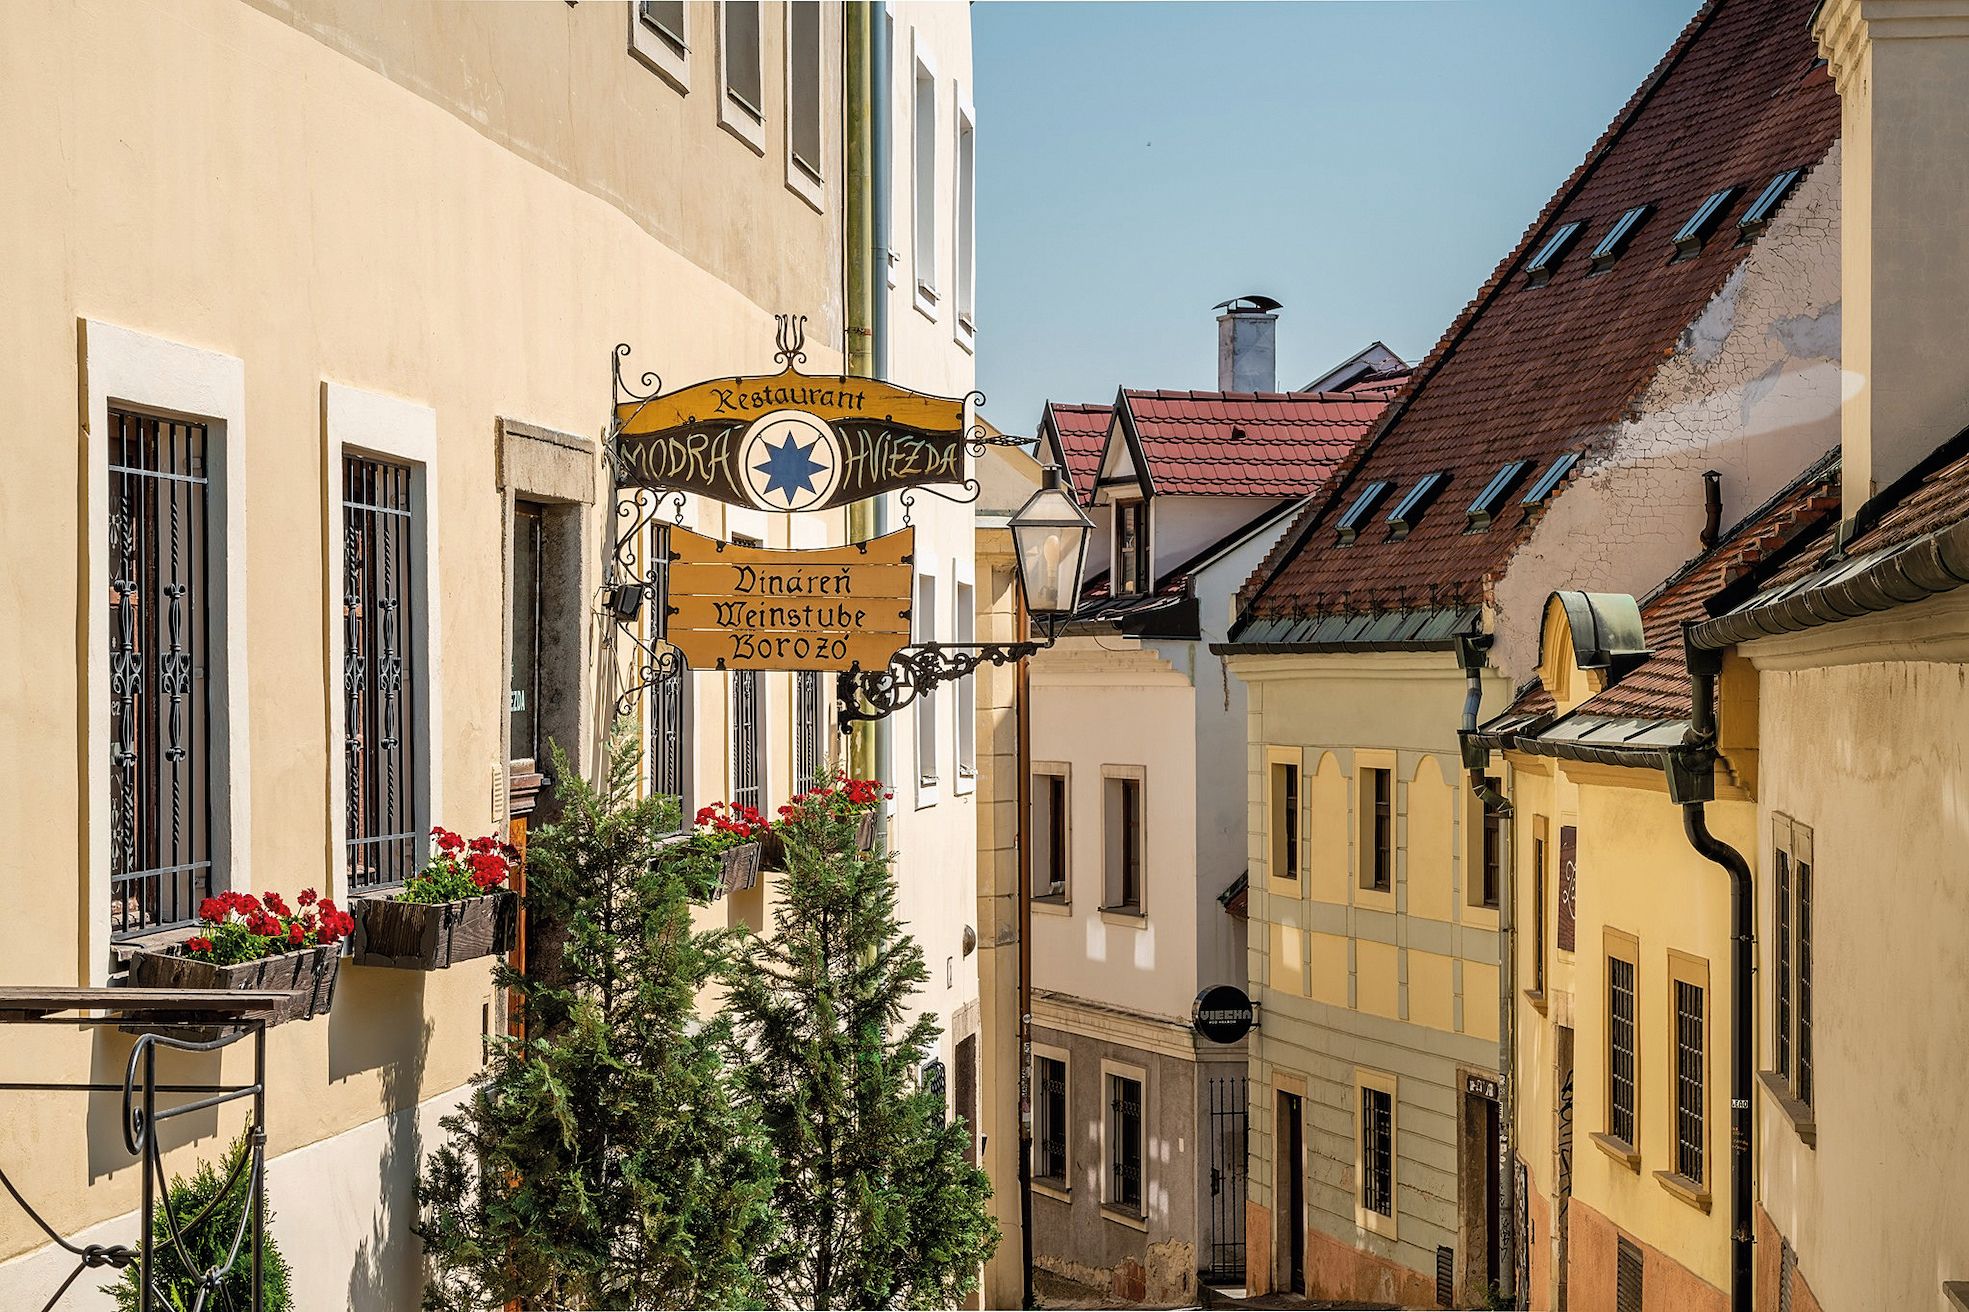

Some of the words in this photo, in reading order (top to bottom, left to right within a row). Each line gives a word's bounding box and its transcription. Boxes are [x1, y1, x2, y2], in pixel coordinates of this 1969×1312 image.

[711, 385, 865, 414] Restaurant
[713, 601, 866, 628] Weinstube
[729, 634, 849, 660] Borozó
[1200, 1009, 1251, 1020] VIECHA
